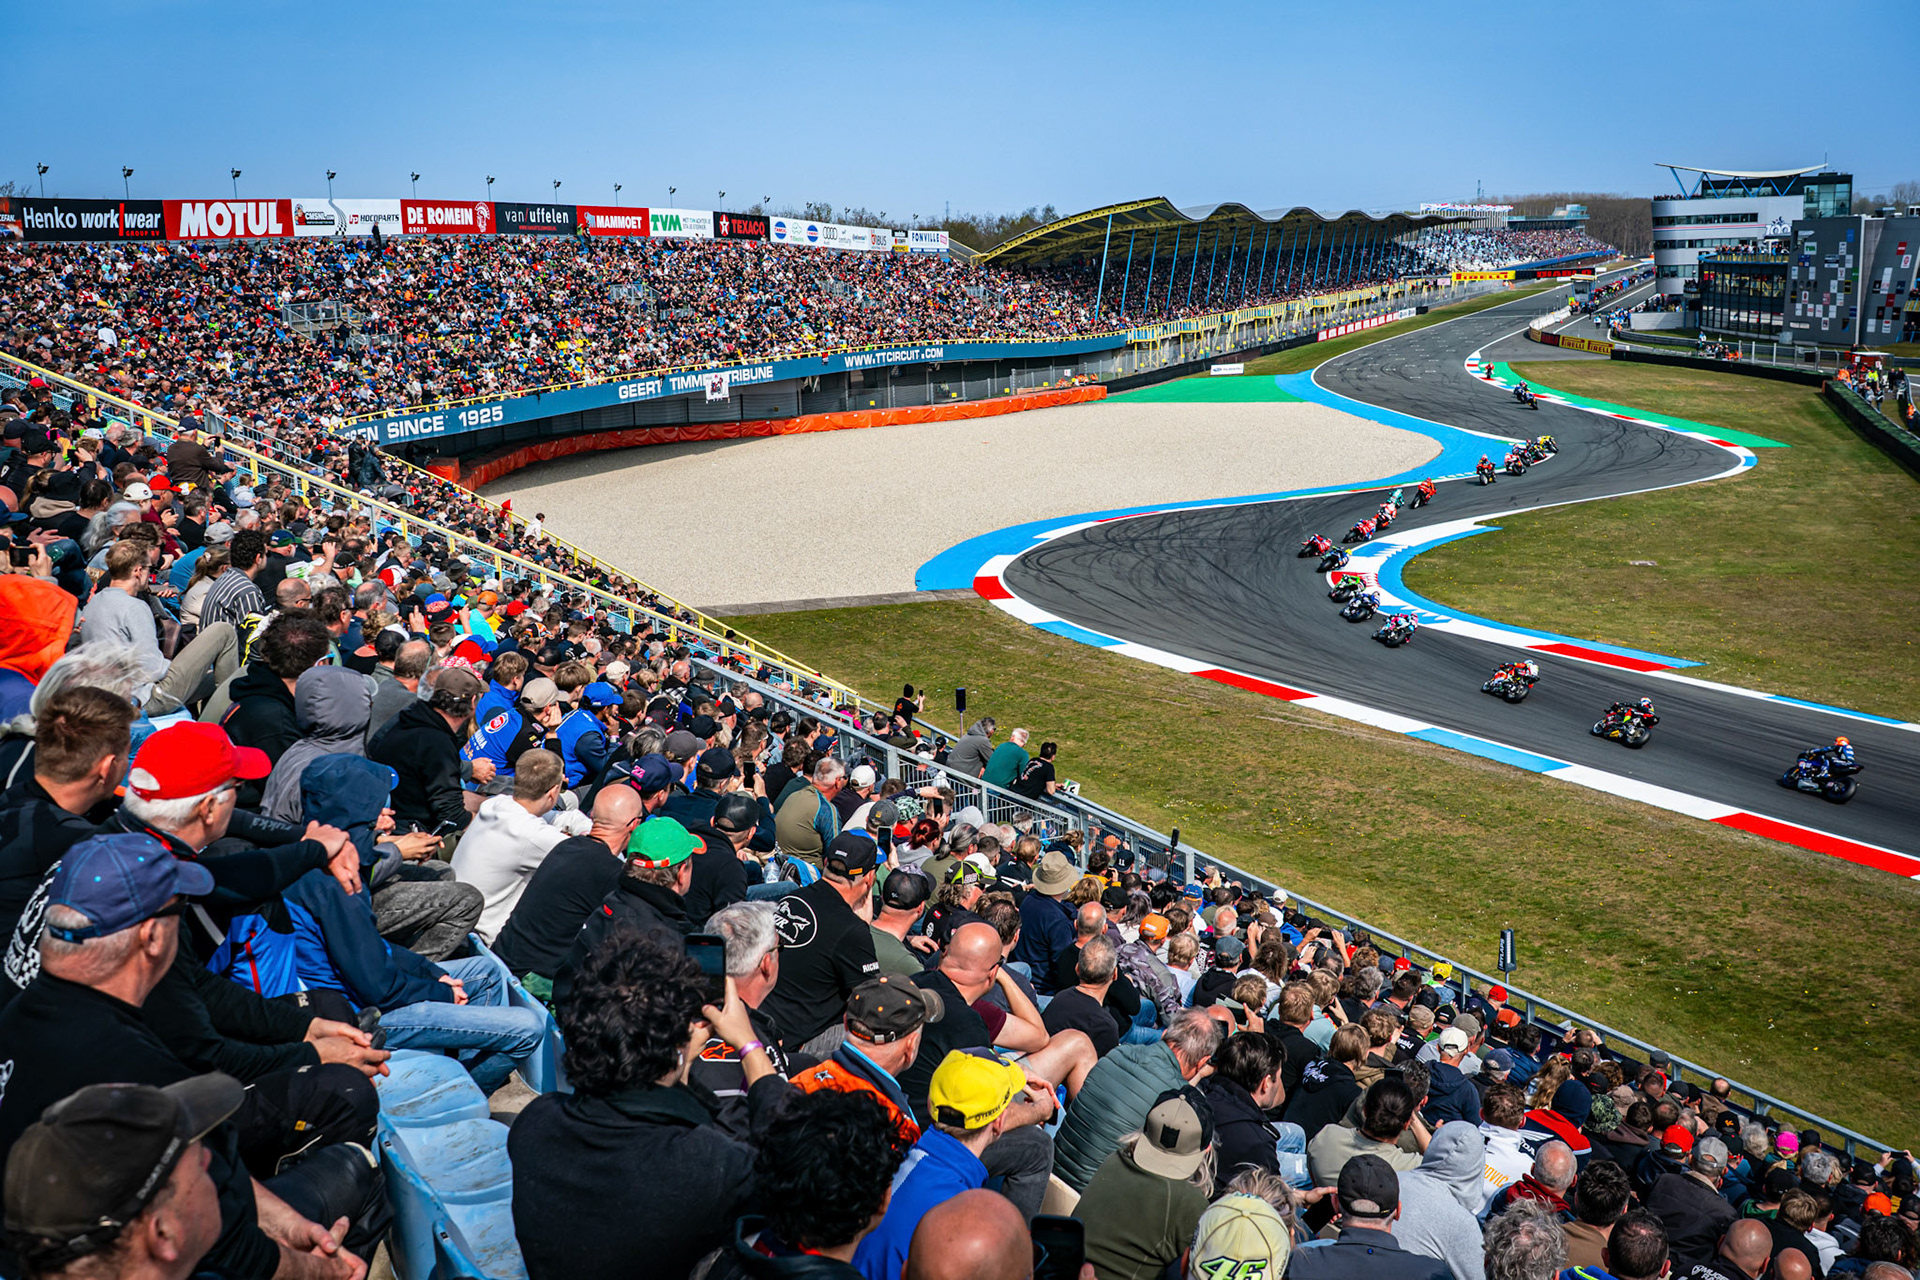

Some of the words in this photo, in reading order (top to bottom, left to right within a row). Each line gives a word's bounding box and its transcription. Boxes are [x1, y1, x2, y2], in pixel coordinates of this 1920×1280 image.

[23, 206, 77, 229] Henko
[179, 202, 283, 237] MOTUL
[360, 214, 400, 223] HOCOPARTS
[407, 207, 424, 225] DE
[427, 207, 474, 226] ROMEIN
[596, 215, 642, 230] MAMMOET
[651, 214, 683, 231] TVM
[731, 218, 766, 236] TEXACO
[911, 232, 940, 243] FONVILLE
[1561, 336, 1585, 350] PIRELLI
[618, 379, 662, 399] GEERT
[669, 373, 706, 391] TIMM
[387, 415, 445, 439] SINCE
[458, 405, 504, 428] 1925
[1199, 1255, 1268, 1280] 46
